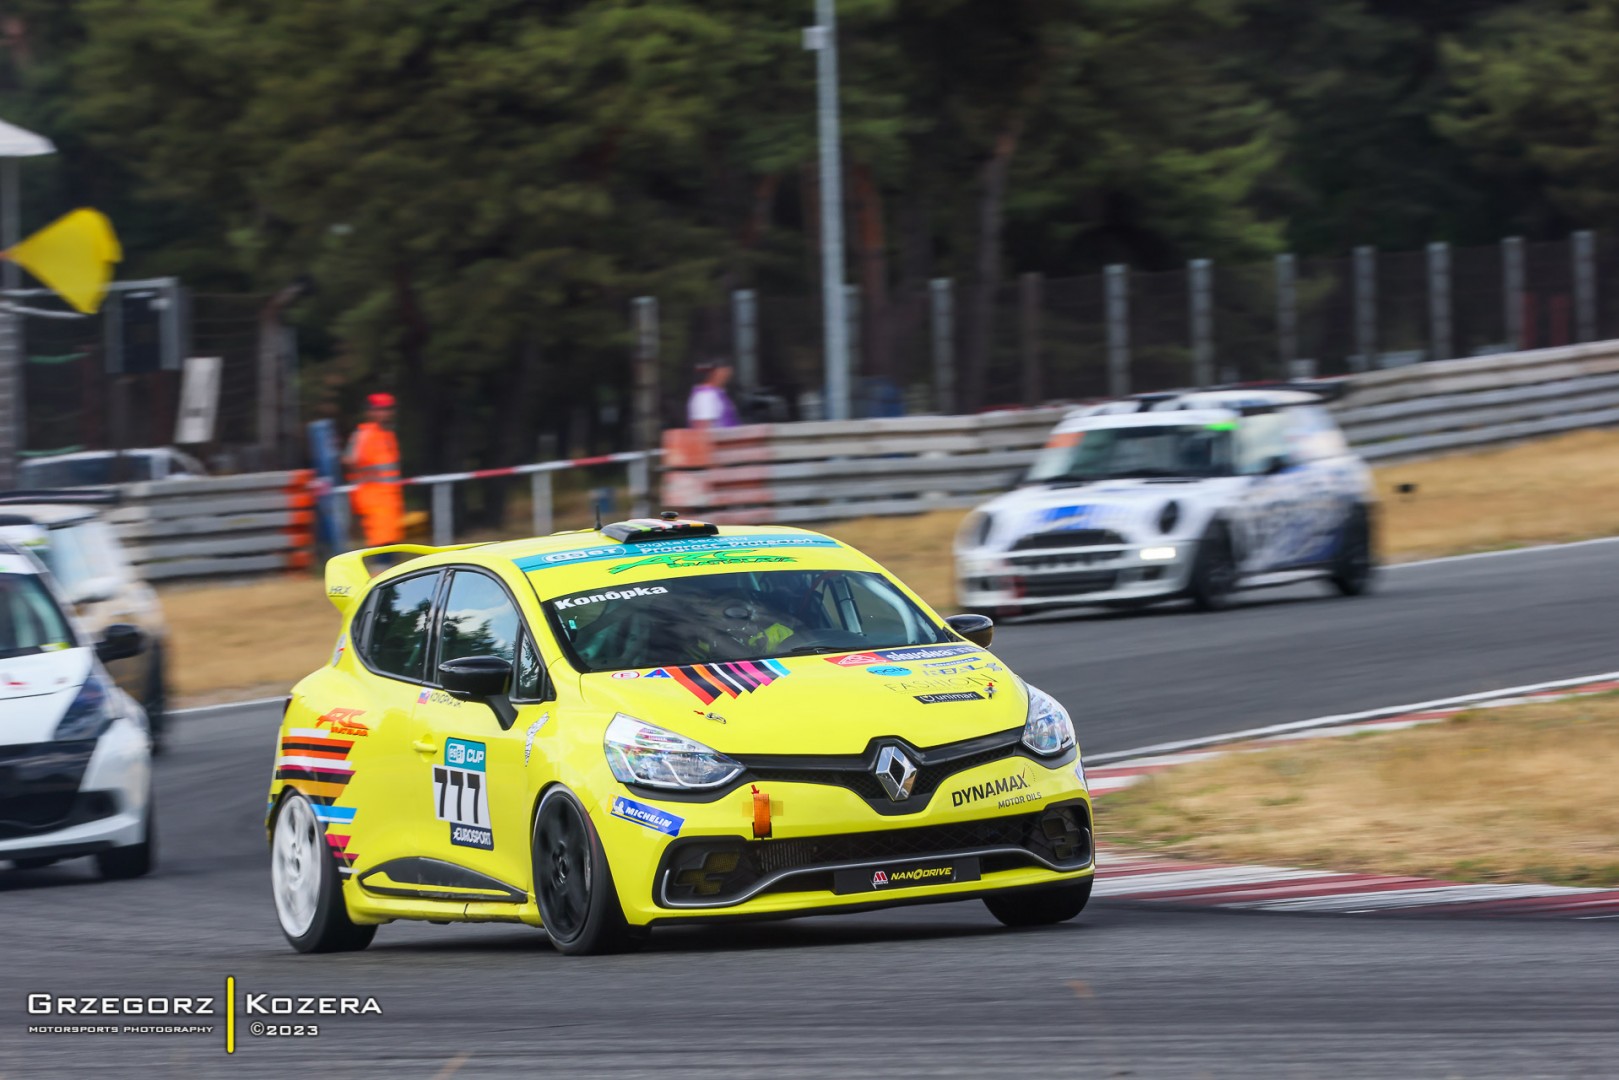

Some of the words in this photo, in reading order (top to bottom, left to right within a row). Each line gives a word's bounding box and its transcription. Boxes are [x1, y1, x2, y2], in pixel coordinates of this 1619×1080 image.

[635, 539, 685, 549] Digital
[554, 586, 669, 610] Konôpka
[466, 749, 484, 763] CUP
[434, 767, 480, 824] 777
[951, 772, 1029, 807] DYNAMAX
[998, 795, 1025, 809] MOTOR
[1026, 792, 1042, 802] OILS
[625, 806, 672, 828] MICHELIN
[455, 827, 492, 847] EUROSPORT
[891, 867, 952, 880] NANODRIVE
